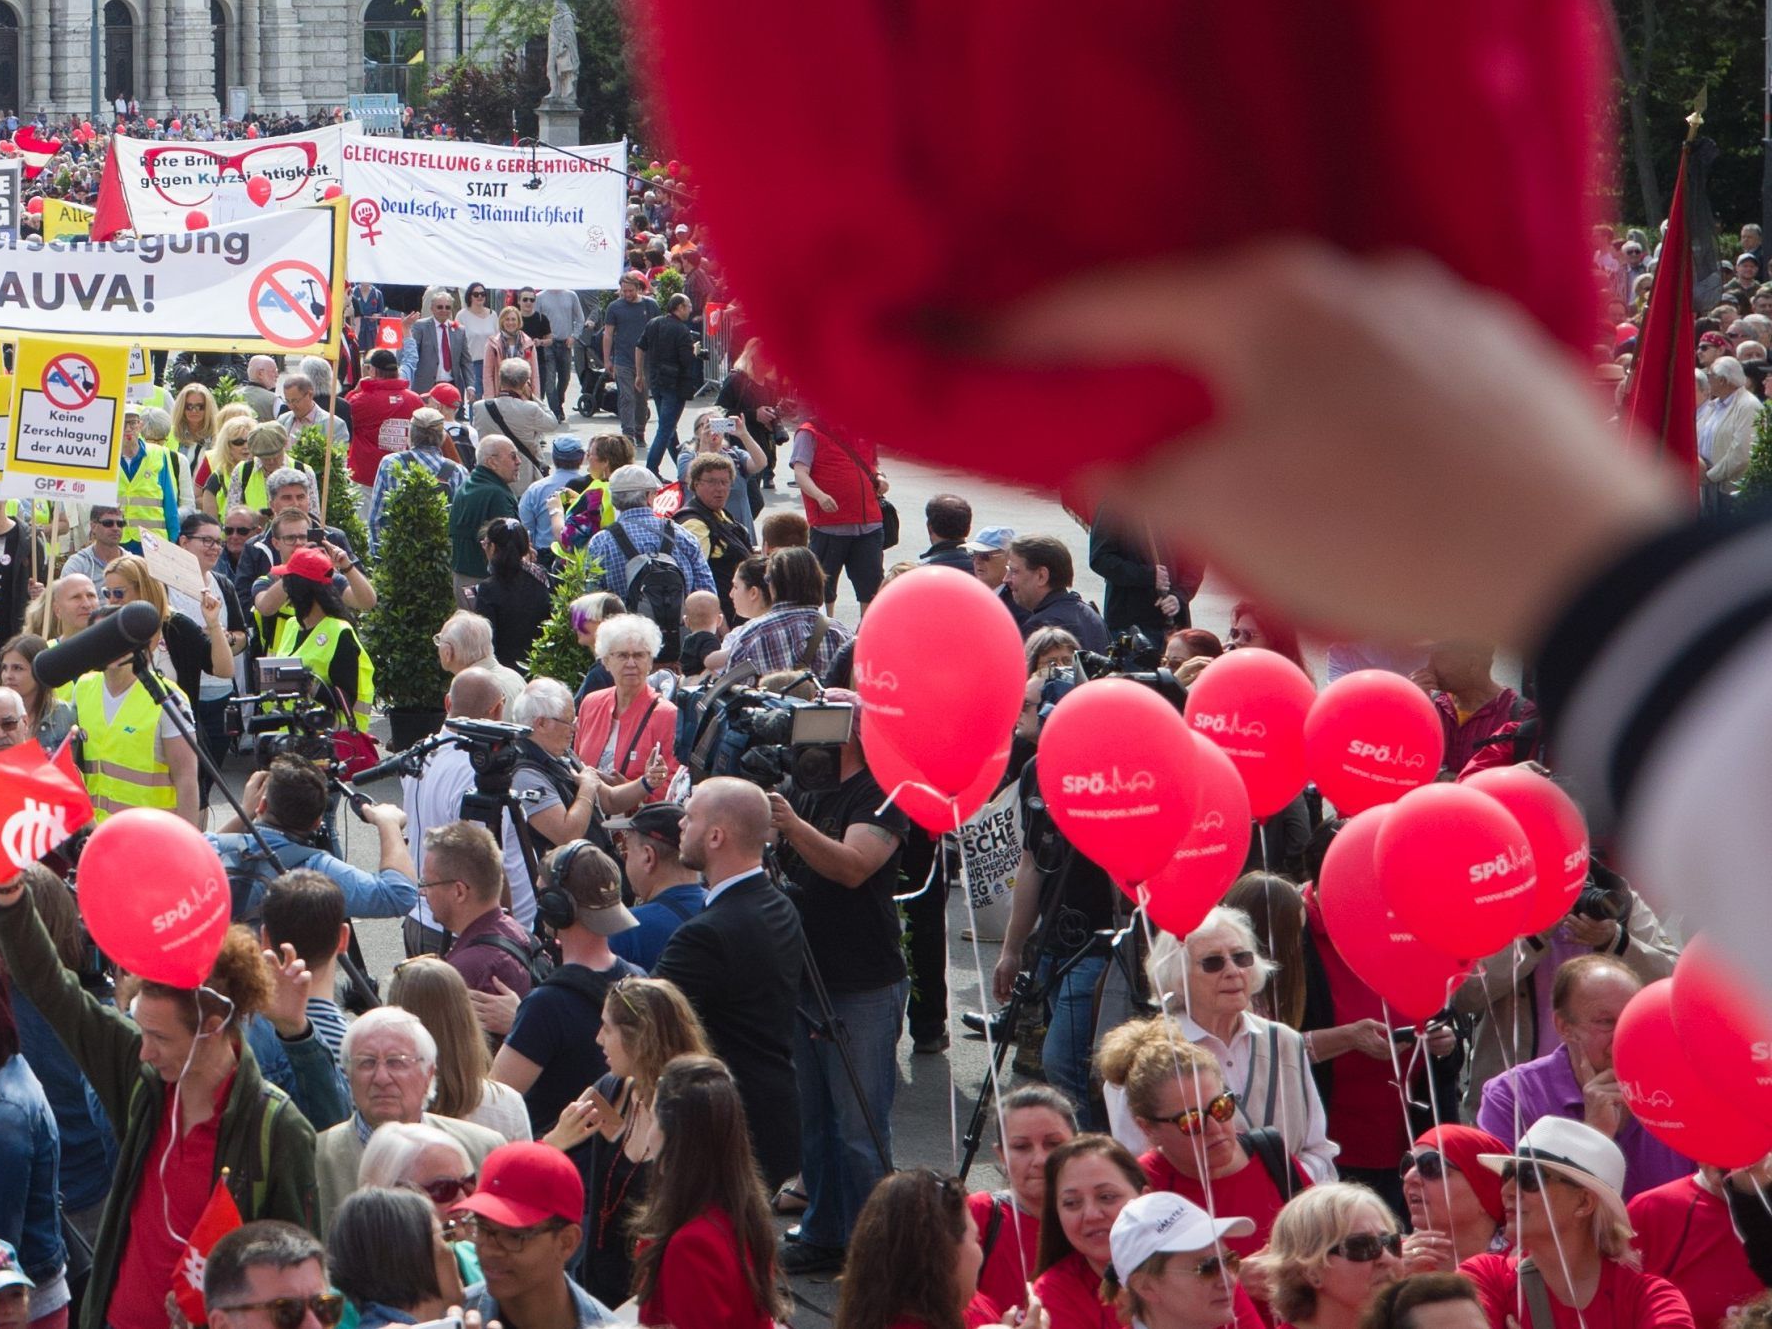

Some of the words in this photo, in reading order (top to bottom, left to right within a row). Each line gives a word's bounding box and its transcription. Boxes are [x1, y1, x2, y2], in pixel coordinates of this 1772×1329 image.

[140, 156, 178, 168] Rote
[184, 155, 228, 167] Brille
[343, 145, 481, 172] GLEICHSTELLUNG
[484, 159, 493, 171] &
[140, 174, 192, 188] gegen
[198, 165, 332, 185] Kurzsihtigkeit.
[466, 182, 508, 198] STATT
[381, 196, 458, 222] deutscher
[467, 203, 585, 227] Männlichkeit
[49, 410, 85, 423] Keine
[23, 424, 108, 445] Zerschlagung
[31, 442, 54, 455] der
[57, 445, 96, 457] AUVA!
[72, 483, 85, 493] djp
[1194, 712, 1226, 732] SPÖ
[1347, 739, 1391, 763] SPÖ
[1062, 772, 1104, 794] SPÖ
[1469, 855, 1509, 883] SPÖ
[1564, 844, 1589, 873] SPÖ
[151, 898, 191, 934] SPÖ
